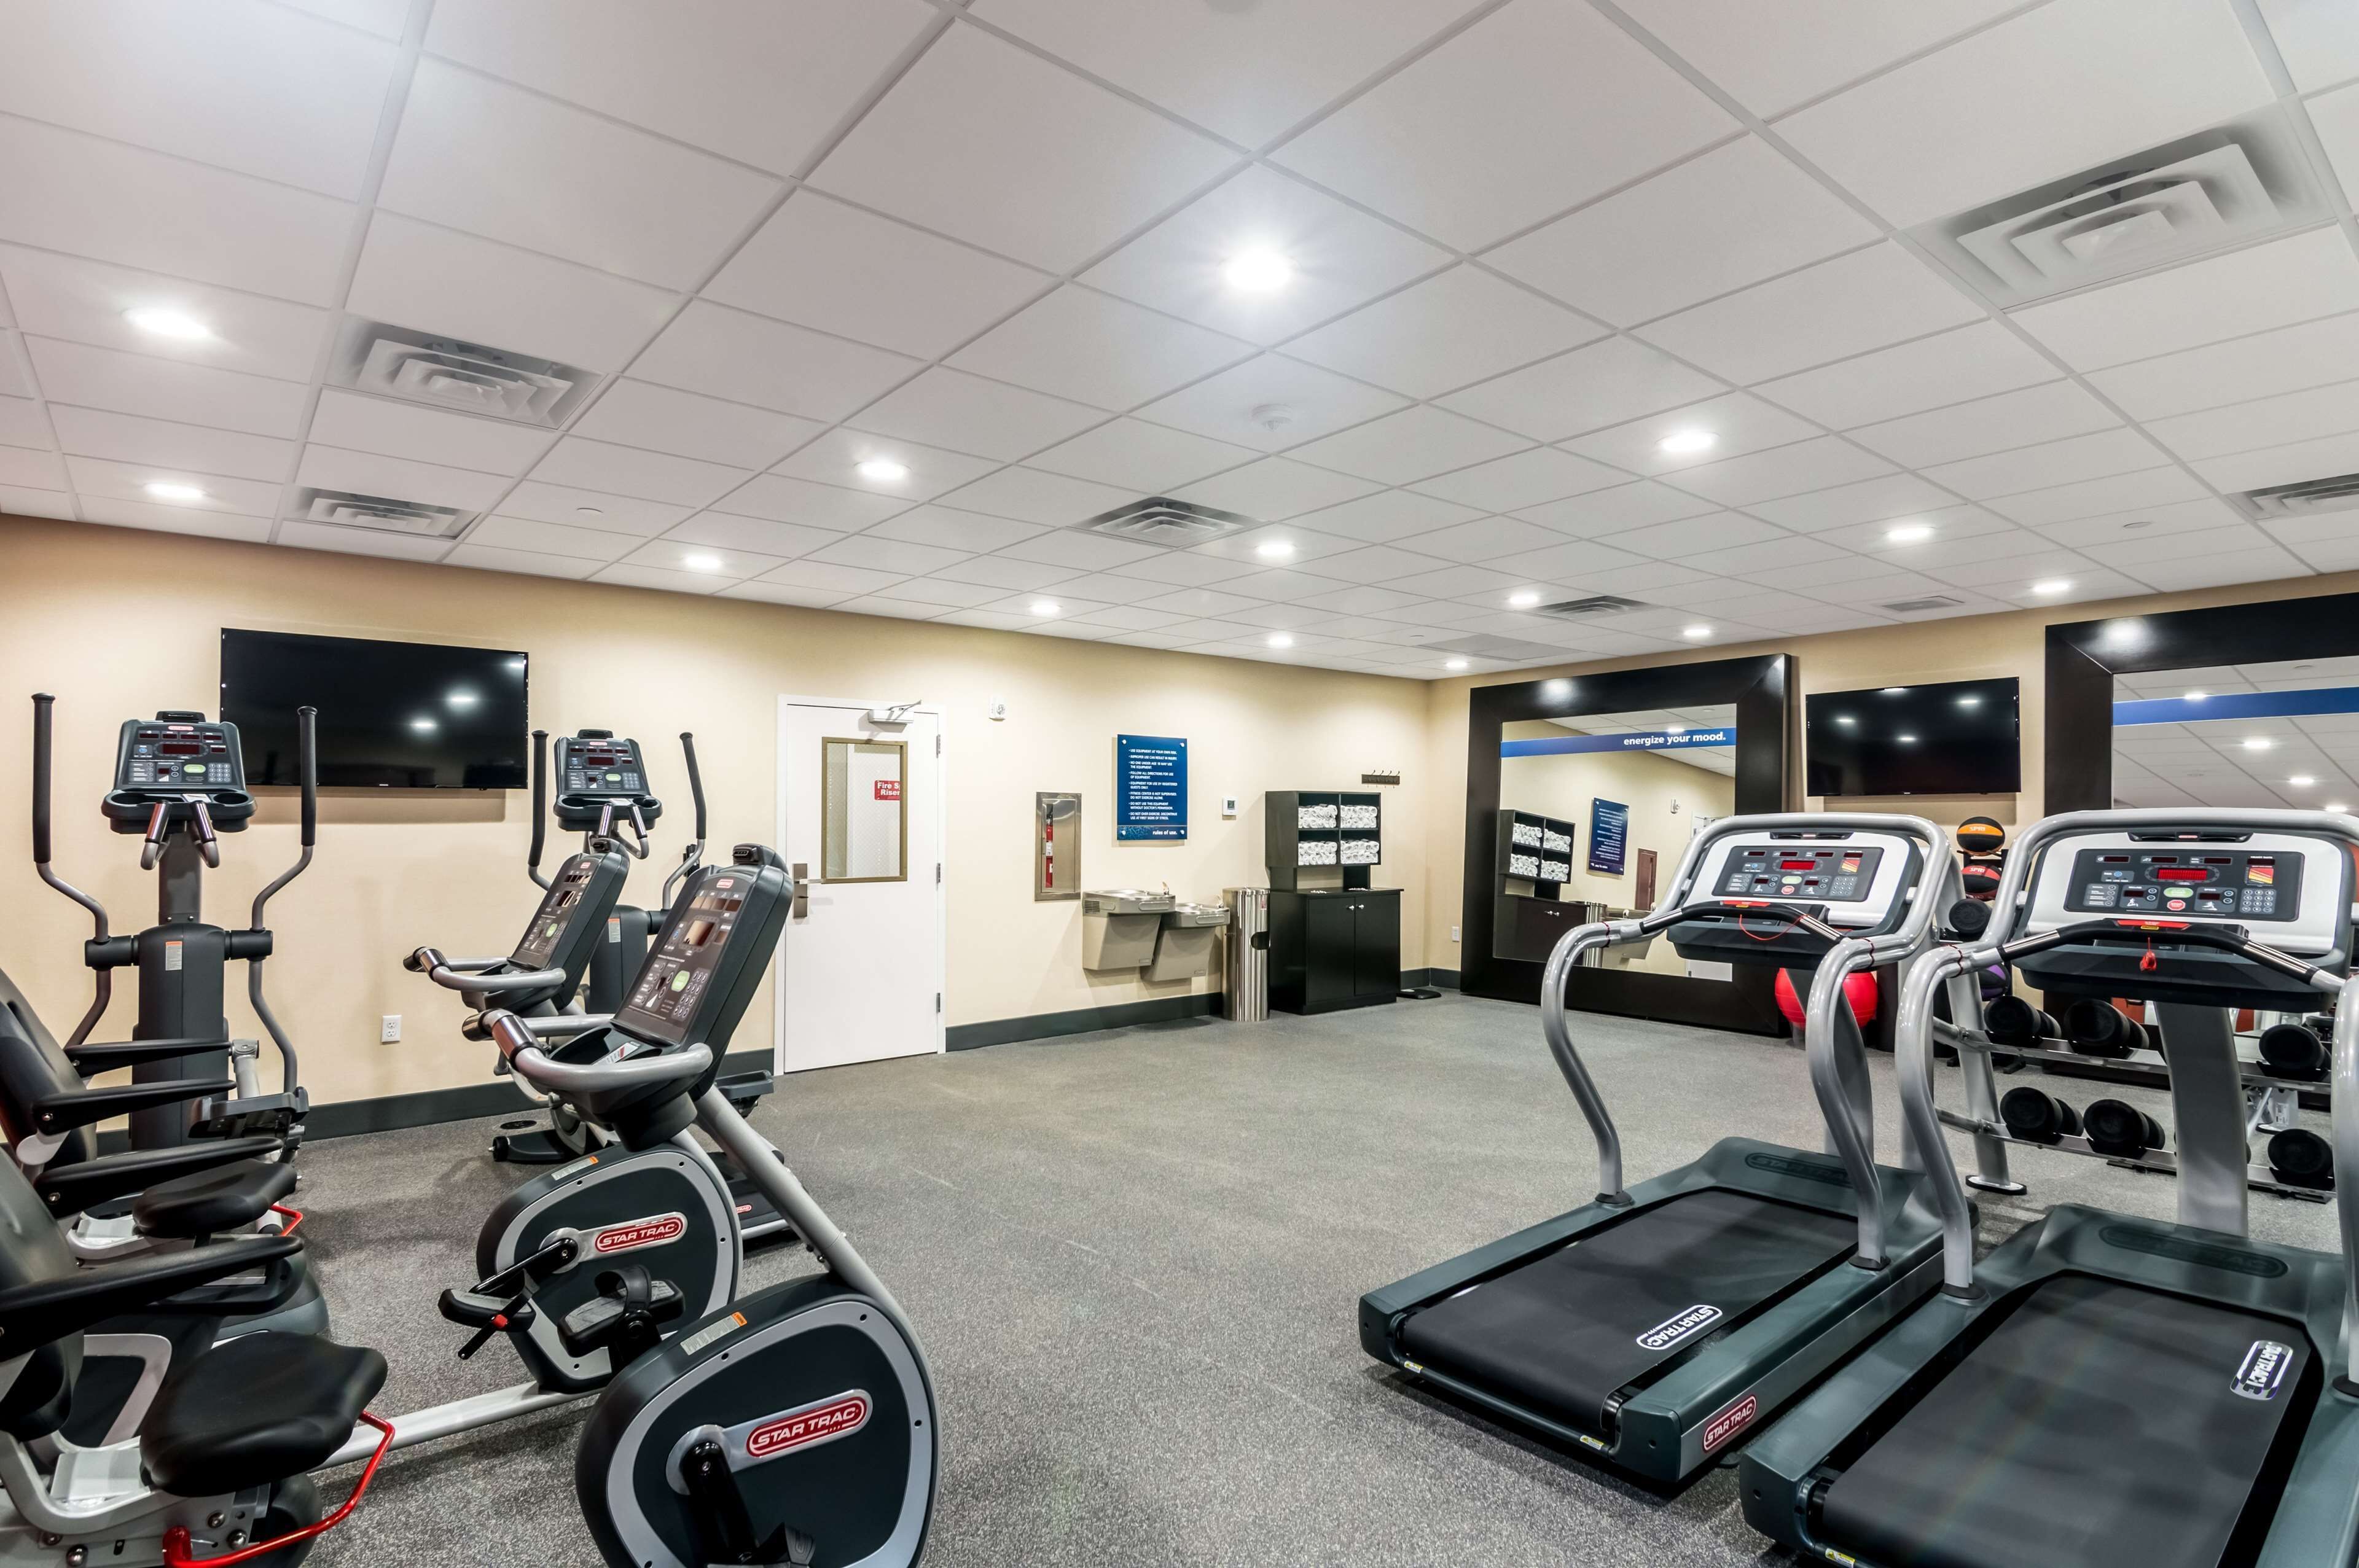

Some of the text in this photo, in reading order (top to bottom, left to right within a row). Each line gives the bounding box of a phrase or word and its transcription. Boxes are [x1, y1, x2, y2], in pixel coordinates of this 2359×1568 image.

[1624, 731, 1727, 746] energize your mood.
[603, 1224, 675, 1245] STAR TRAC
[1647, 1306, 1714, 1346] STAR TRAC
[758, 1407, 855, 1445] STAR TRAC
[1708, 1403, 1752, 1440] STAR TRAC
